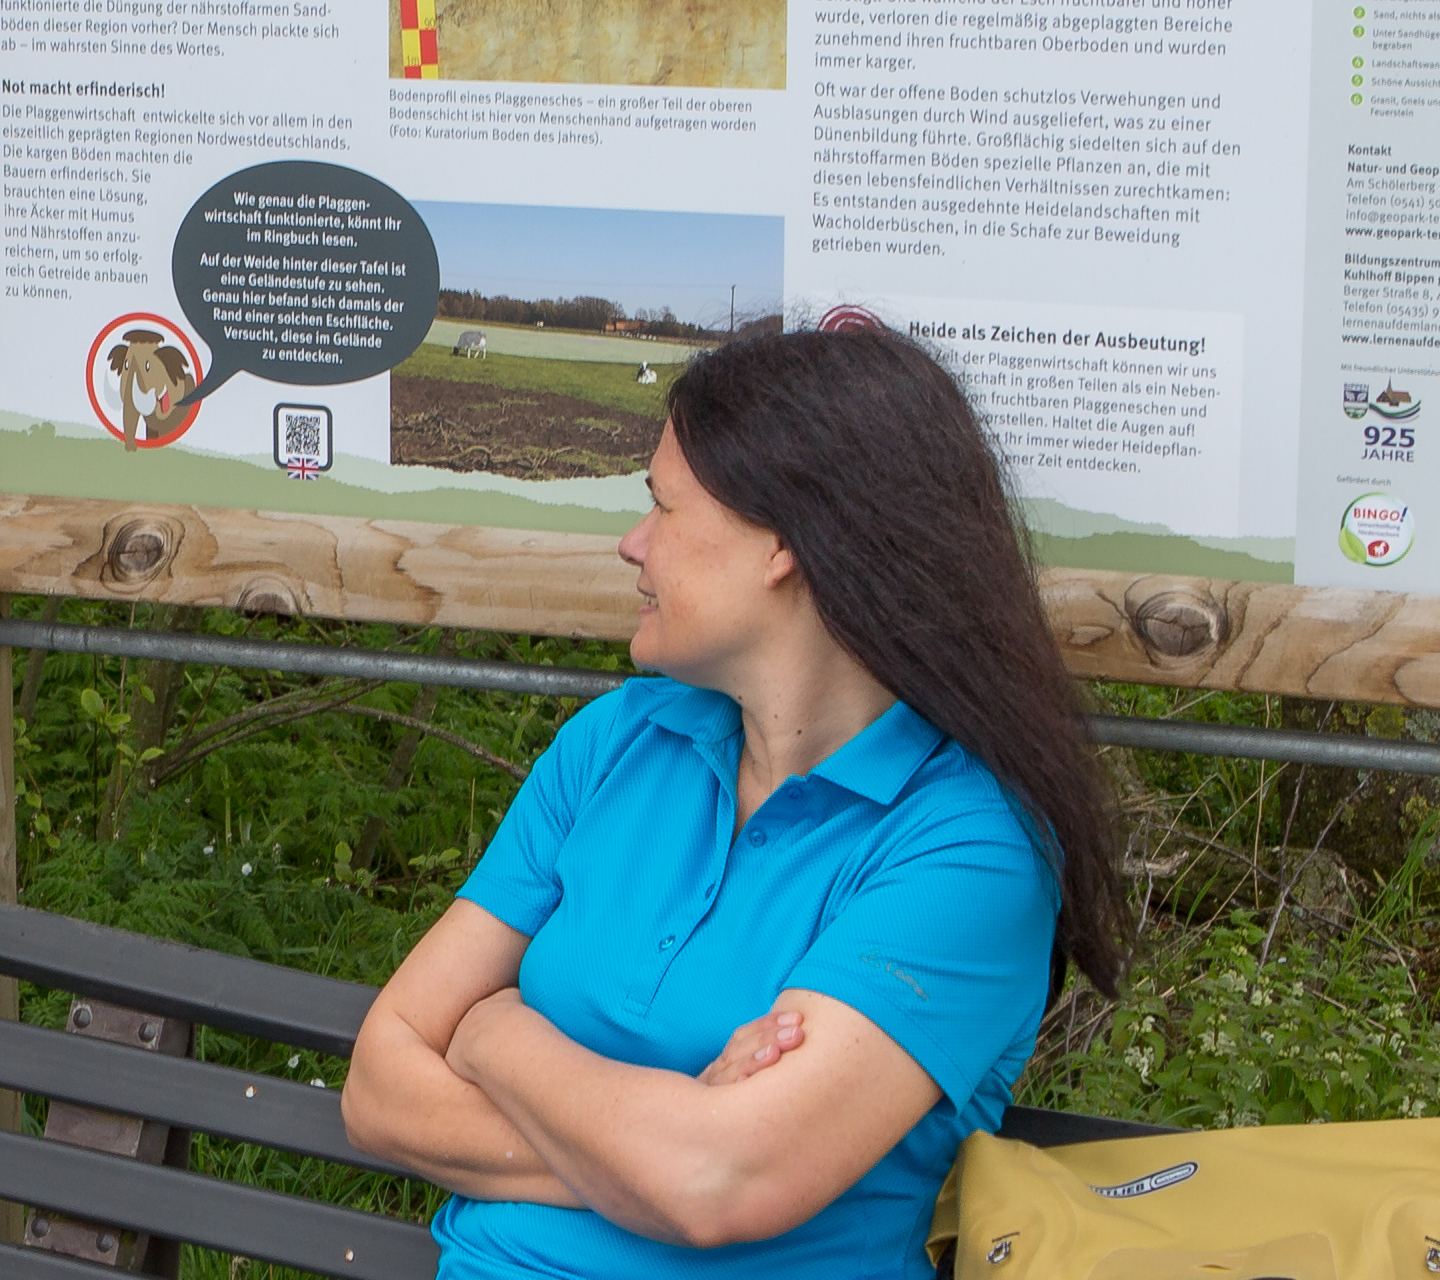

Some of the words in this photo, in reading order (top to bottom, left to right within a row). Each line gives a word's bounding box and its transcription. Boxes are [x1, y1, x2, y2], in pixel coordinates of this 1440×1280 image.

[2, 78, 25, 94] Not
[29, 80, 72, 96] macht
[76, 81, 165, 99] erfinderisch!
[1348, 143, 1392, 157] Kontakt
[1347, 161, 1382, 174] Natur-
[1385, 163, 1407, 175] und
[233, 192, 256, 207] Wie
[259, 196, 295, 211] genau
[296, 194, 316, 209] die
[318, 195, 371, 213] Plaggen-
[1344, 253, 1440, 269] Bildungszentrum
[1344, 269, 1392, 282] Kuhlhoff
[1394, 271, 1435, 286] Bippen
[909, 321, 957, 339] Heide
[961, 323, 986, 341] als
[990, 325, 1057, 345] Zeichen
[1062, 329, 1091, 347] der
[1095, 331, 1206, 356] Ausbeutung!
[1364, 425, 1415, 448] 925
[1360, 449, 1415, 463] JAHRE
